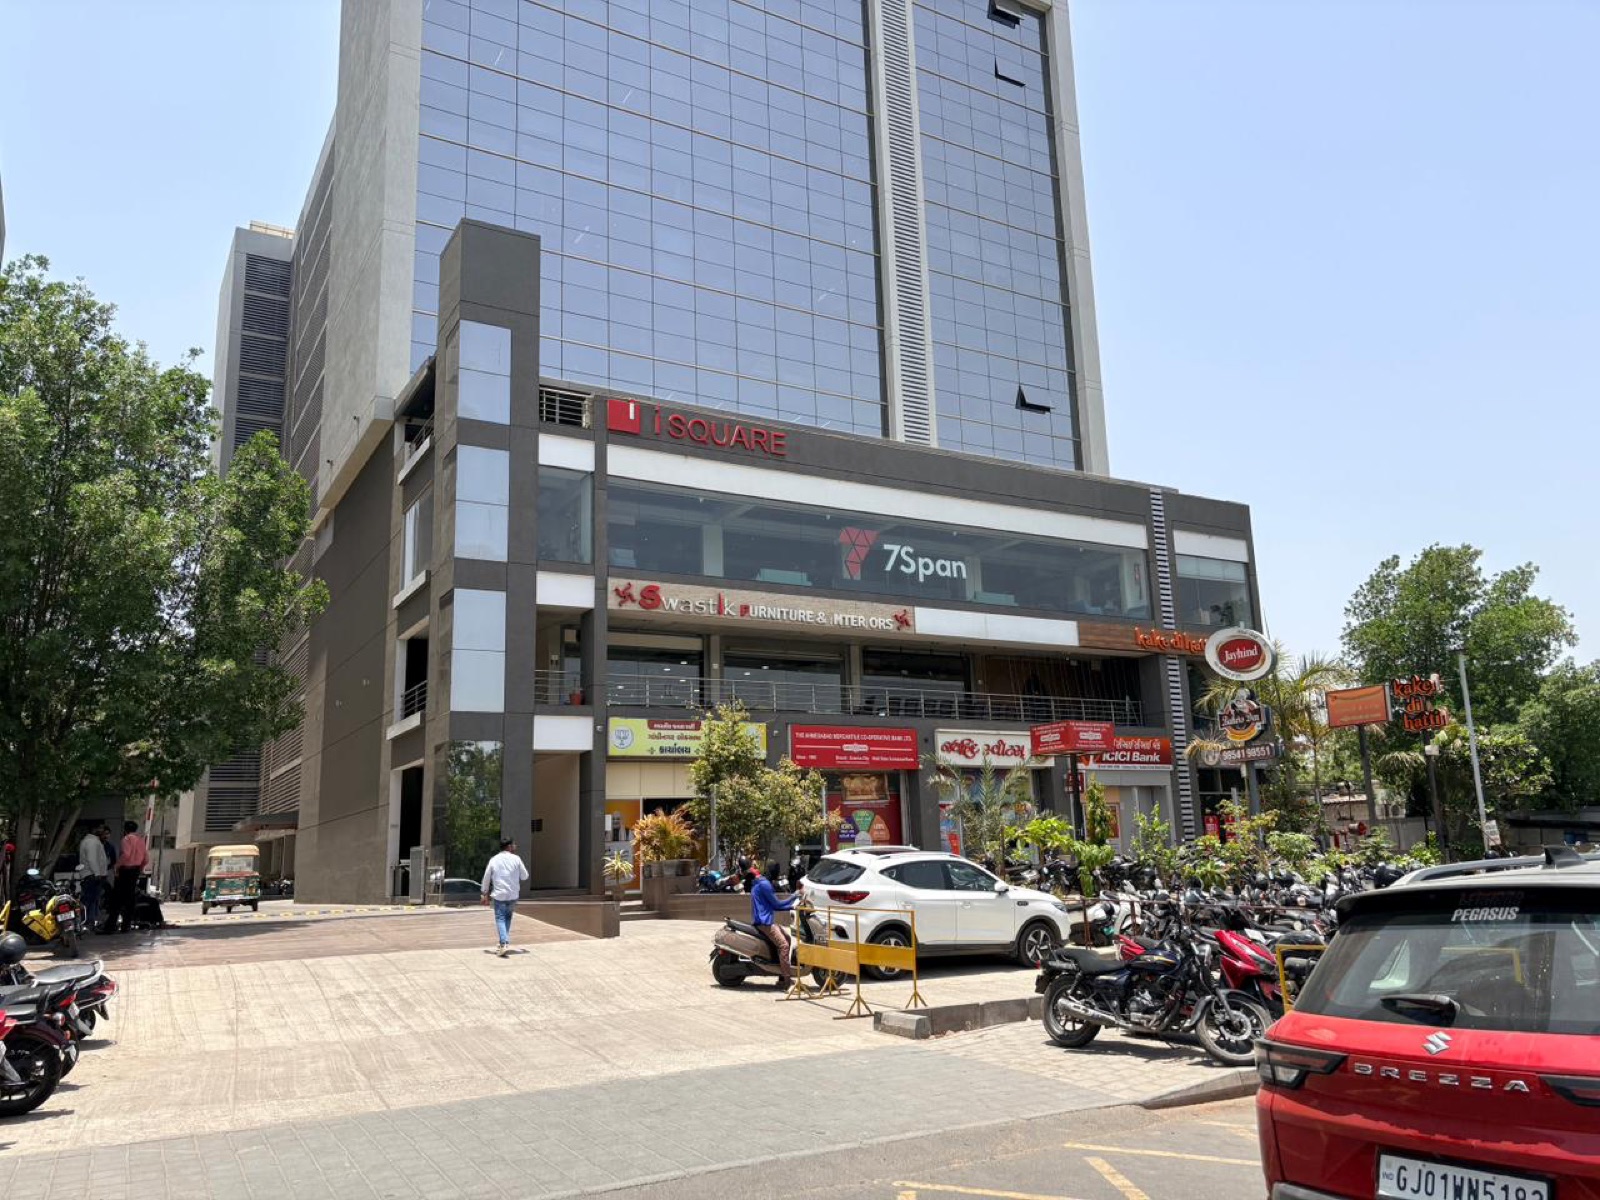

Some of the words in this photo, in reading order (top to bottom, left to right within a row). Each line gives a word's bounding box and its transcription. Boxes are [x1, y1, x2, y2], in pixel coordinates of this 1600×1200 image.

[668, 414, 788, 456] SQUARE
[883, 544, 967, 582] 7Span
[740, 604, 815, 623] FURNITURE
[816, 612, 827, 624] &
[1407, 696, 1424, 713] di
[1102, 751, 1131, 762] ICICI
[1132, 751, 1161, 763] Bank
[1451, 907, 1520, 921] PEGASUS
[1354, 1062, 1530, 1092] BREZZA
